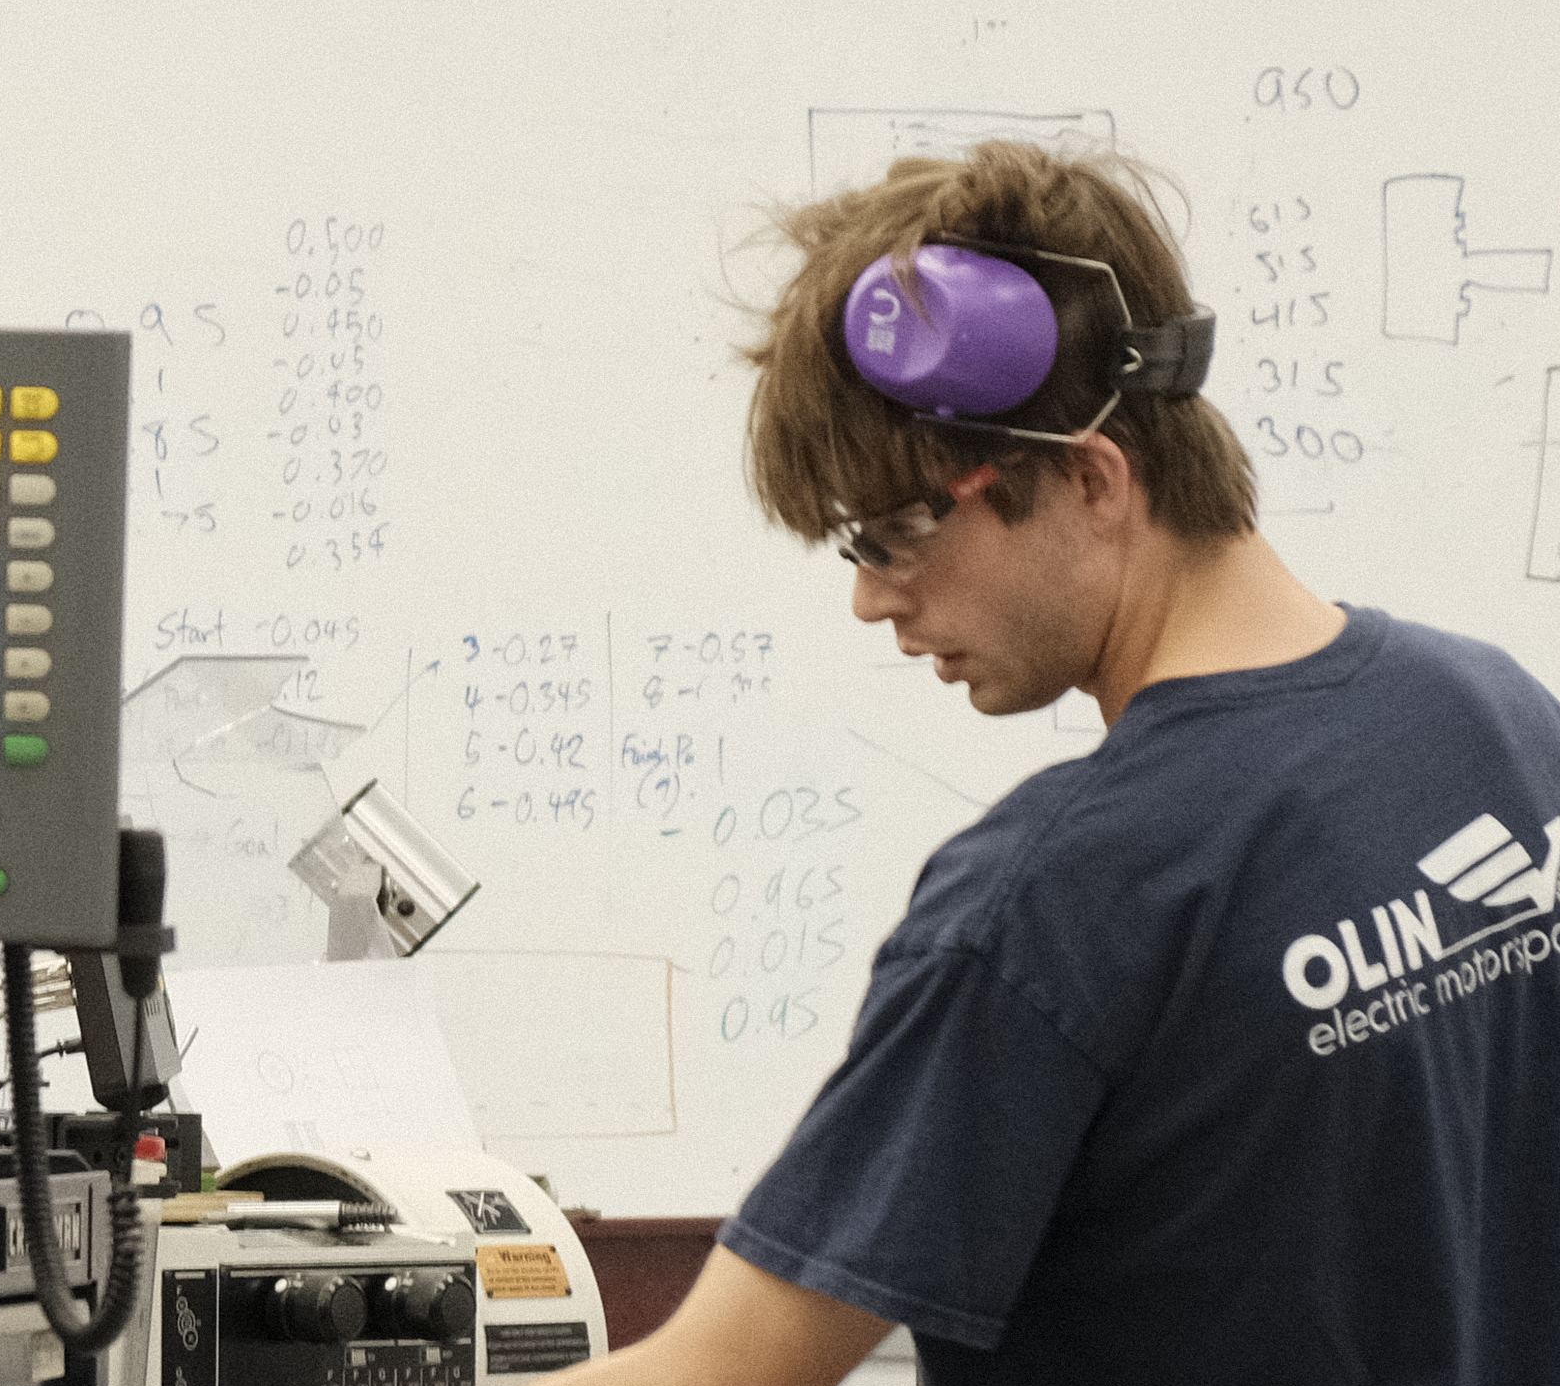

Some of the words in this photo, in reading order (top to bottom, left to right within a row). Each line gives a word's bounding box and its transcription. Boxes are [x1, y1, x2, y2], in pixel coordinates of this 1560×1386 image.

[285, 216, 384, 265] 0.500
[154, 607, 227, 651] Start
[255, 615, 361, 651] -0.045
[682, 631, 773, 665] -0.57
[494, 680, 591, 714] -0.345
[496, 727, 586, 768] -0.42
[1282, 888, 1443, 1010] OLIN
[1308, 979, 1432, 1057] electric
[498, 1250, 552, 1265] Warning
